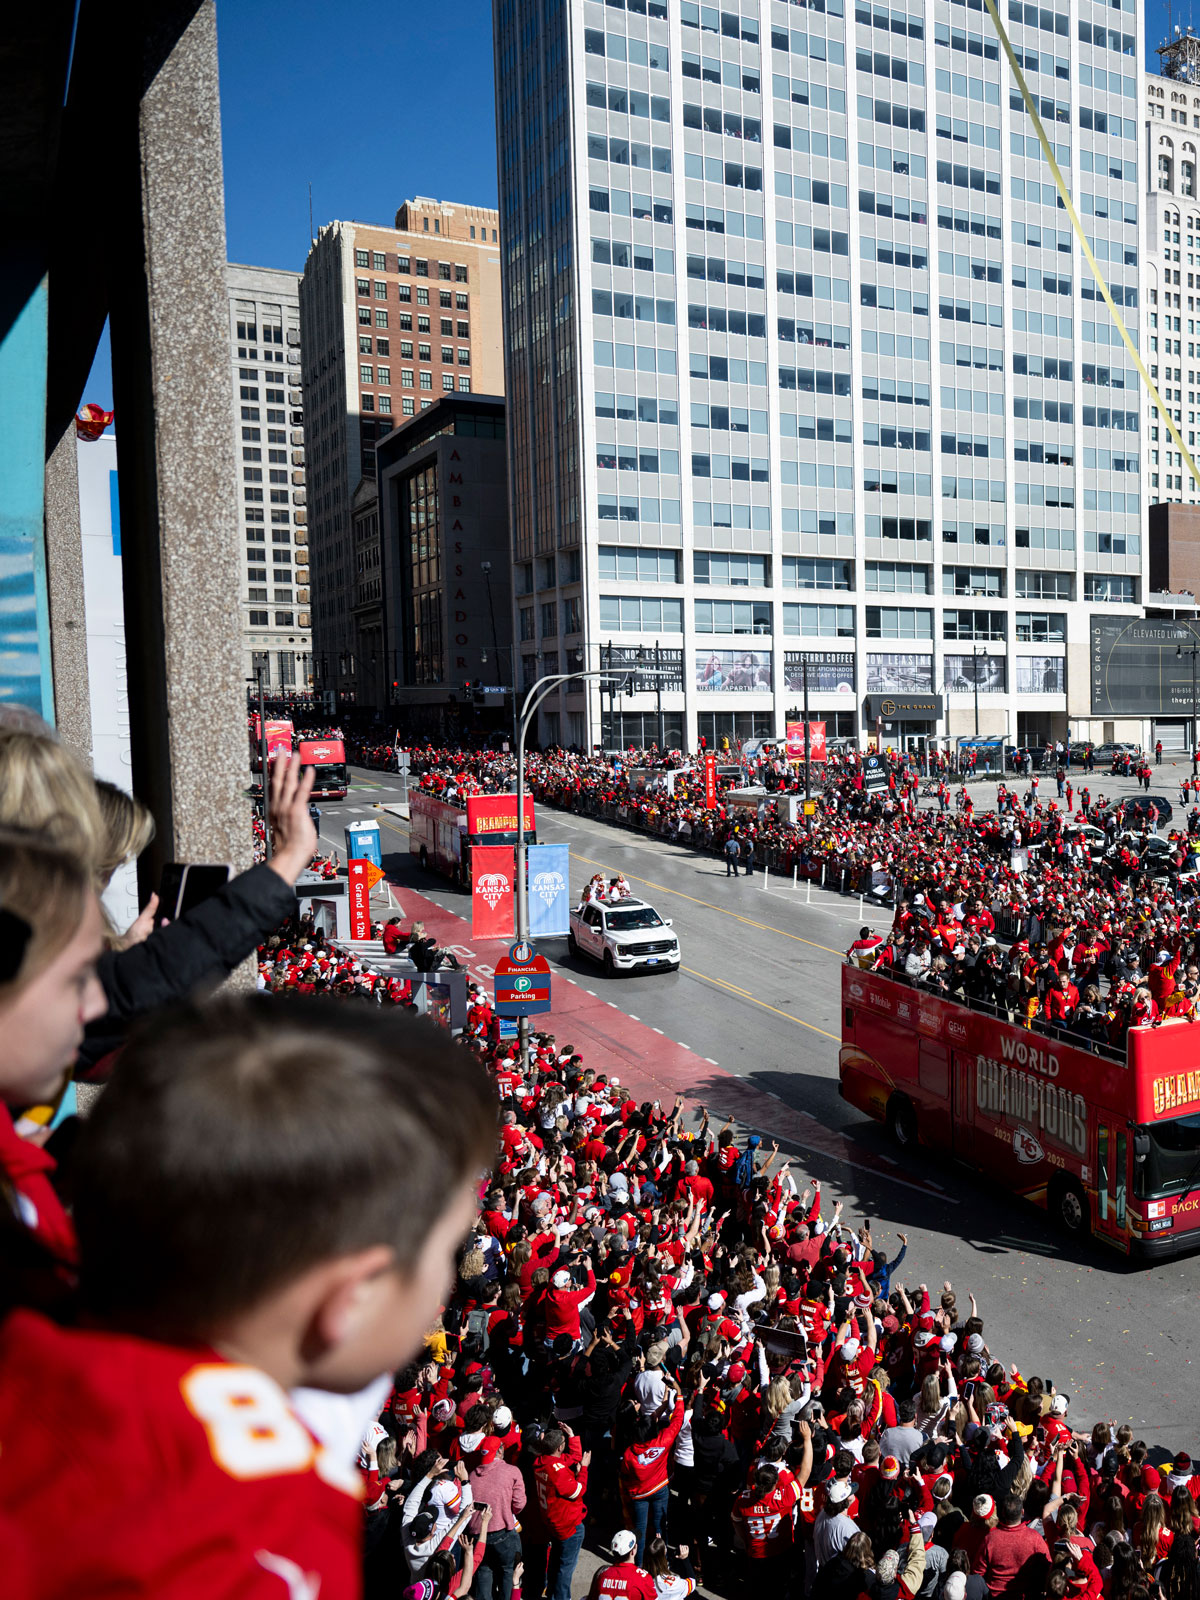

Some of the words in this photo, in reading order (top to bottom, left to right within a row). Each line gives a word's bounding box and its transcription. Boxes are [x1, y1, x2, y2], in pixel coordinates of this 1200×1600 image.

[449, 449, 468, 669] AMBASSADOR
[1133, 630, 1166, 638] ELEVATED
[826, 653, 854, 663] COFFEE
[866, 654, 884, 665] NOW
[888, 655, 932, 665] LEASING
[476, 815, 531, 833] CHAMPIOS
[475, 885, 511, 894] KANSAS
[531, 884, 566, 892] KANSAS
[539, 890, 560, 898] CITY
[355, 883, 364, 909] Grand
[483, 892, 503, 900] CITY
[356, 912, 364, 920] at
[357, 922, 366, 939] 12th
[948, 1020, 967, 1035] GEHA
[1000, 1035, 1060, 1077] WORLD
[976, 1054, 1087, 1155] CHAMPIONS
[1047, 1151, 1065, 1168] 2023
[747, 1513, 781, 1540] 87
[602, 1578, 628, 1590] BOLTON
